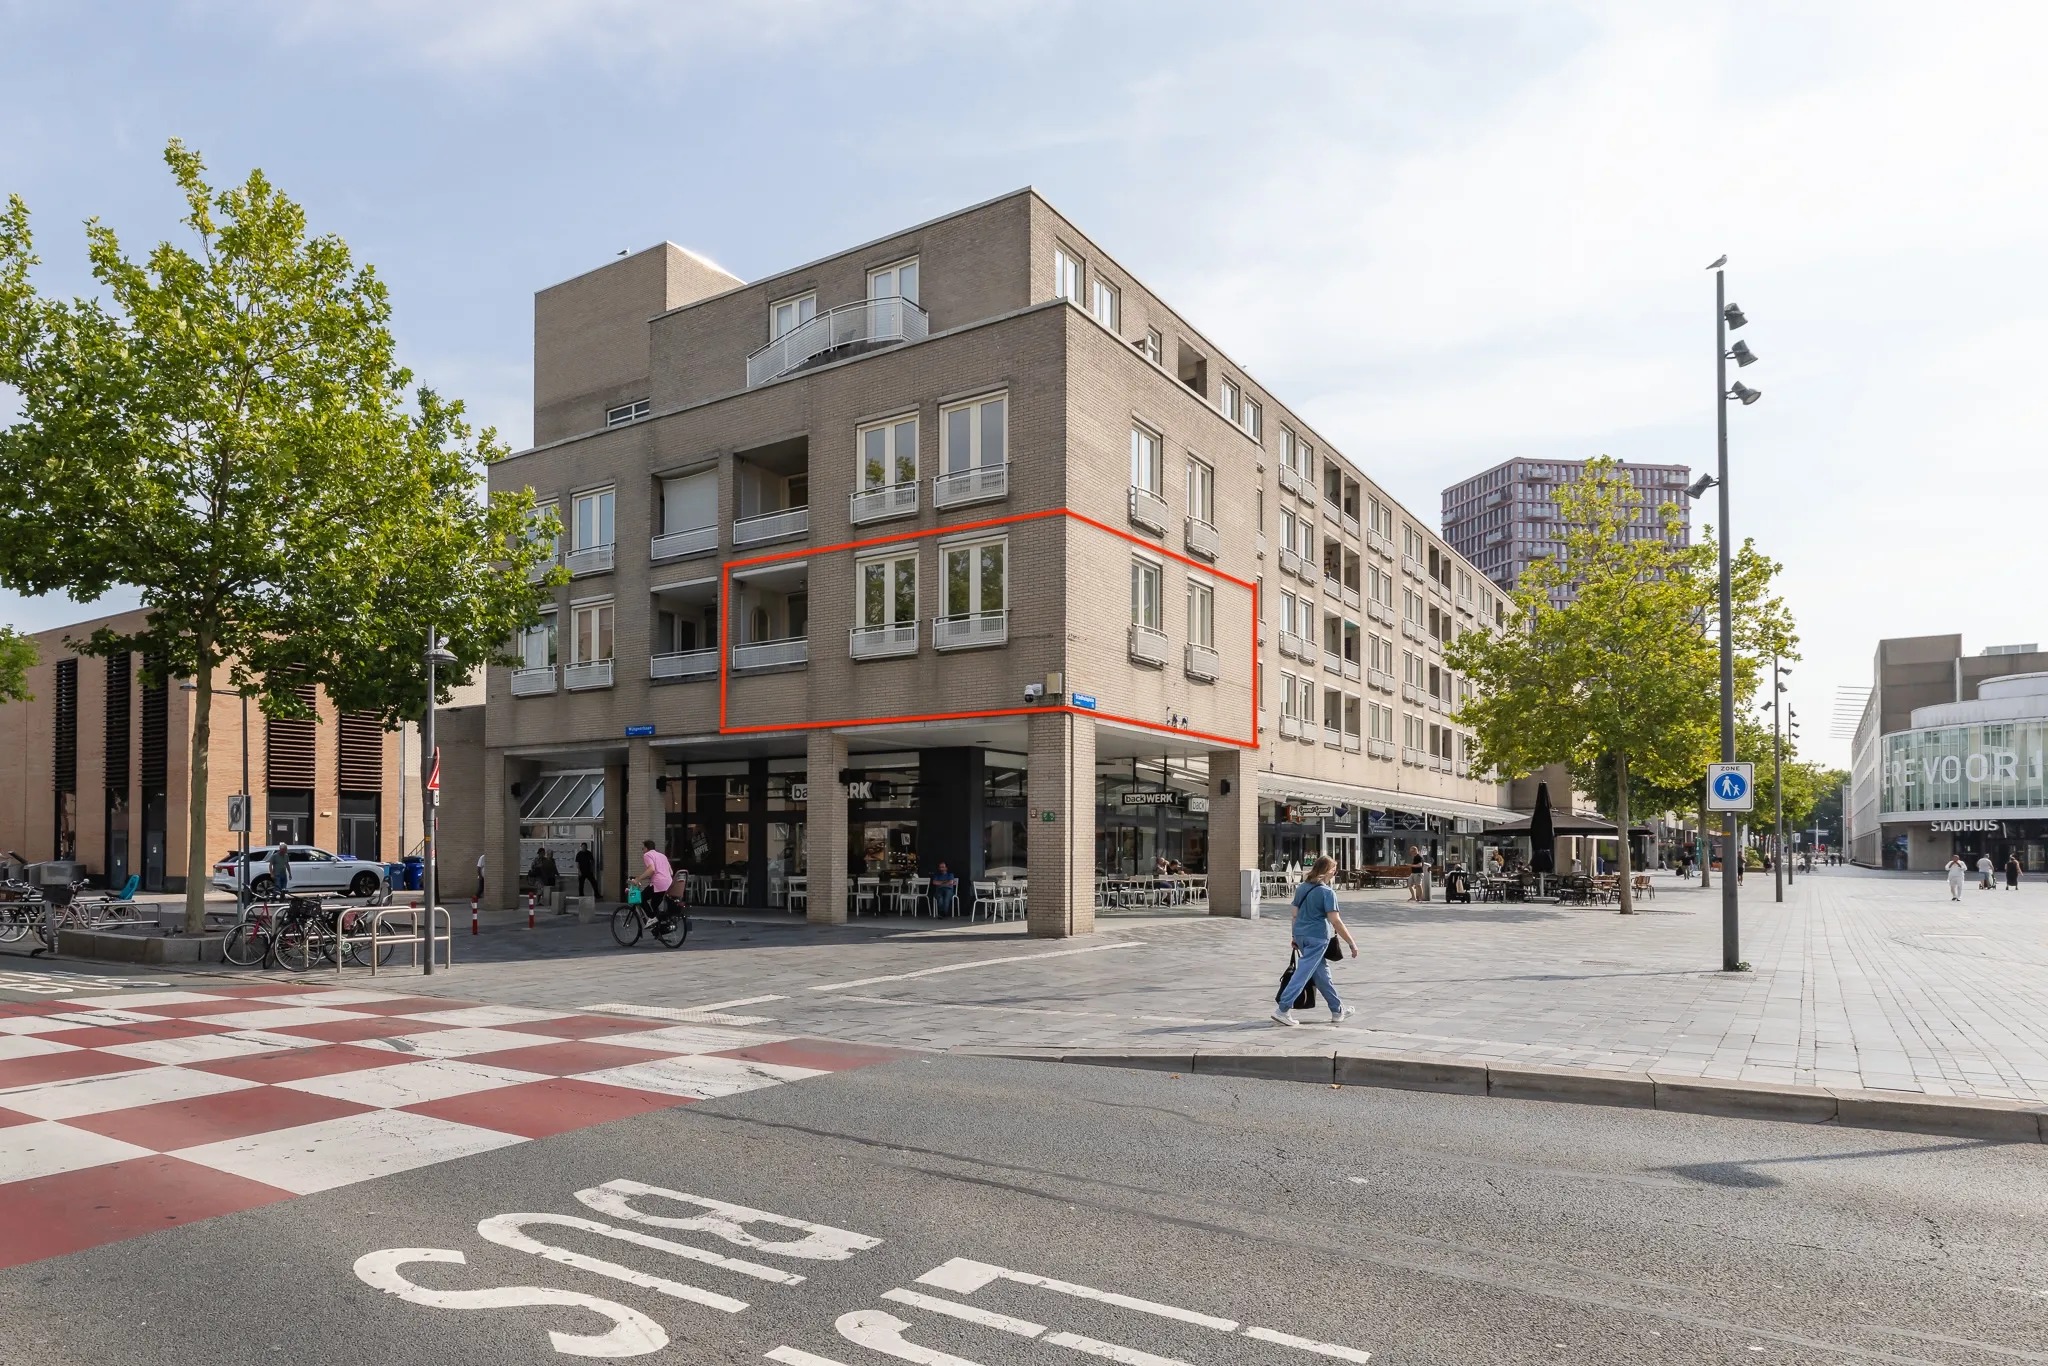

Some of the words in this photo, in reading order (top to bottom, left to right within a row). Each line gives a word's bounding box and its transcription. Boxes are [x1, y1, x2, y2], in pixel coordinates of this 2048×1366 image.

[1922, 751, 2020, 785] VOOR
[1930, 819, 1999, 832] STADHUIS
[353, 1178, 884, 1358] BUS
